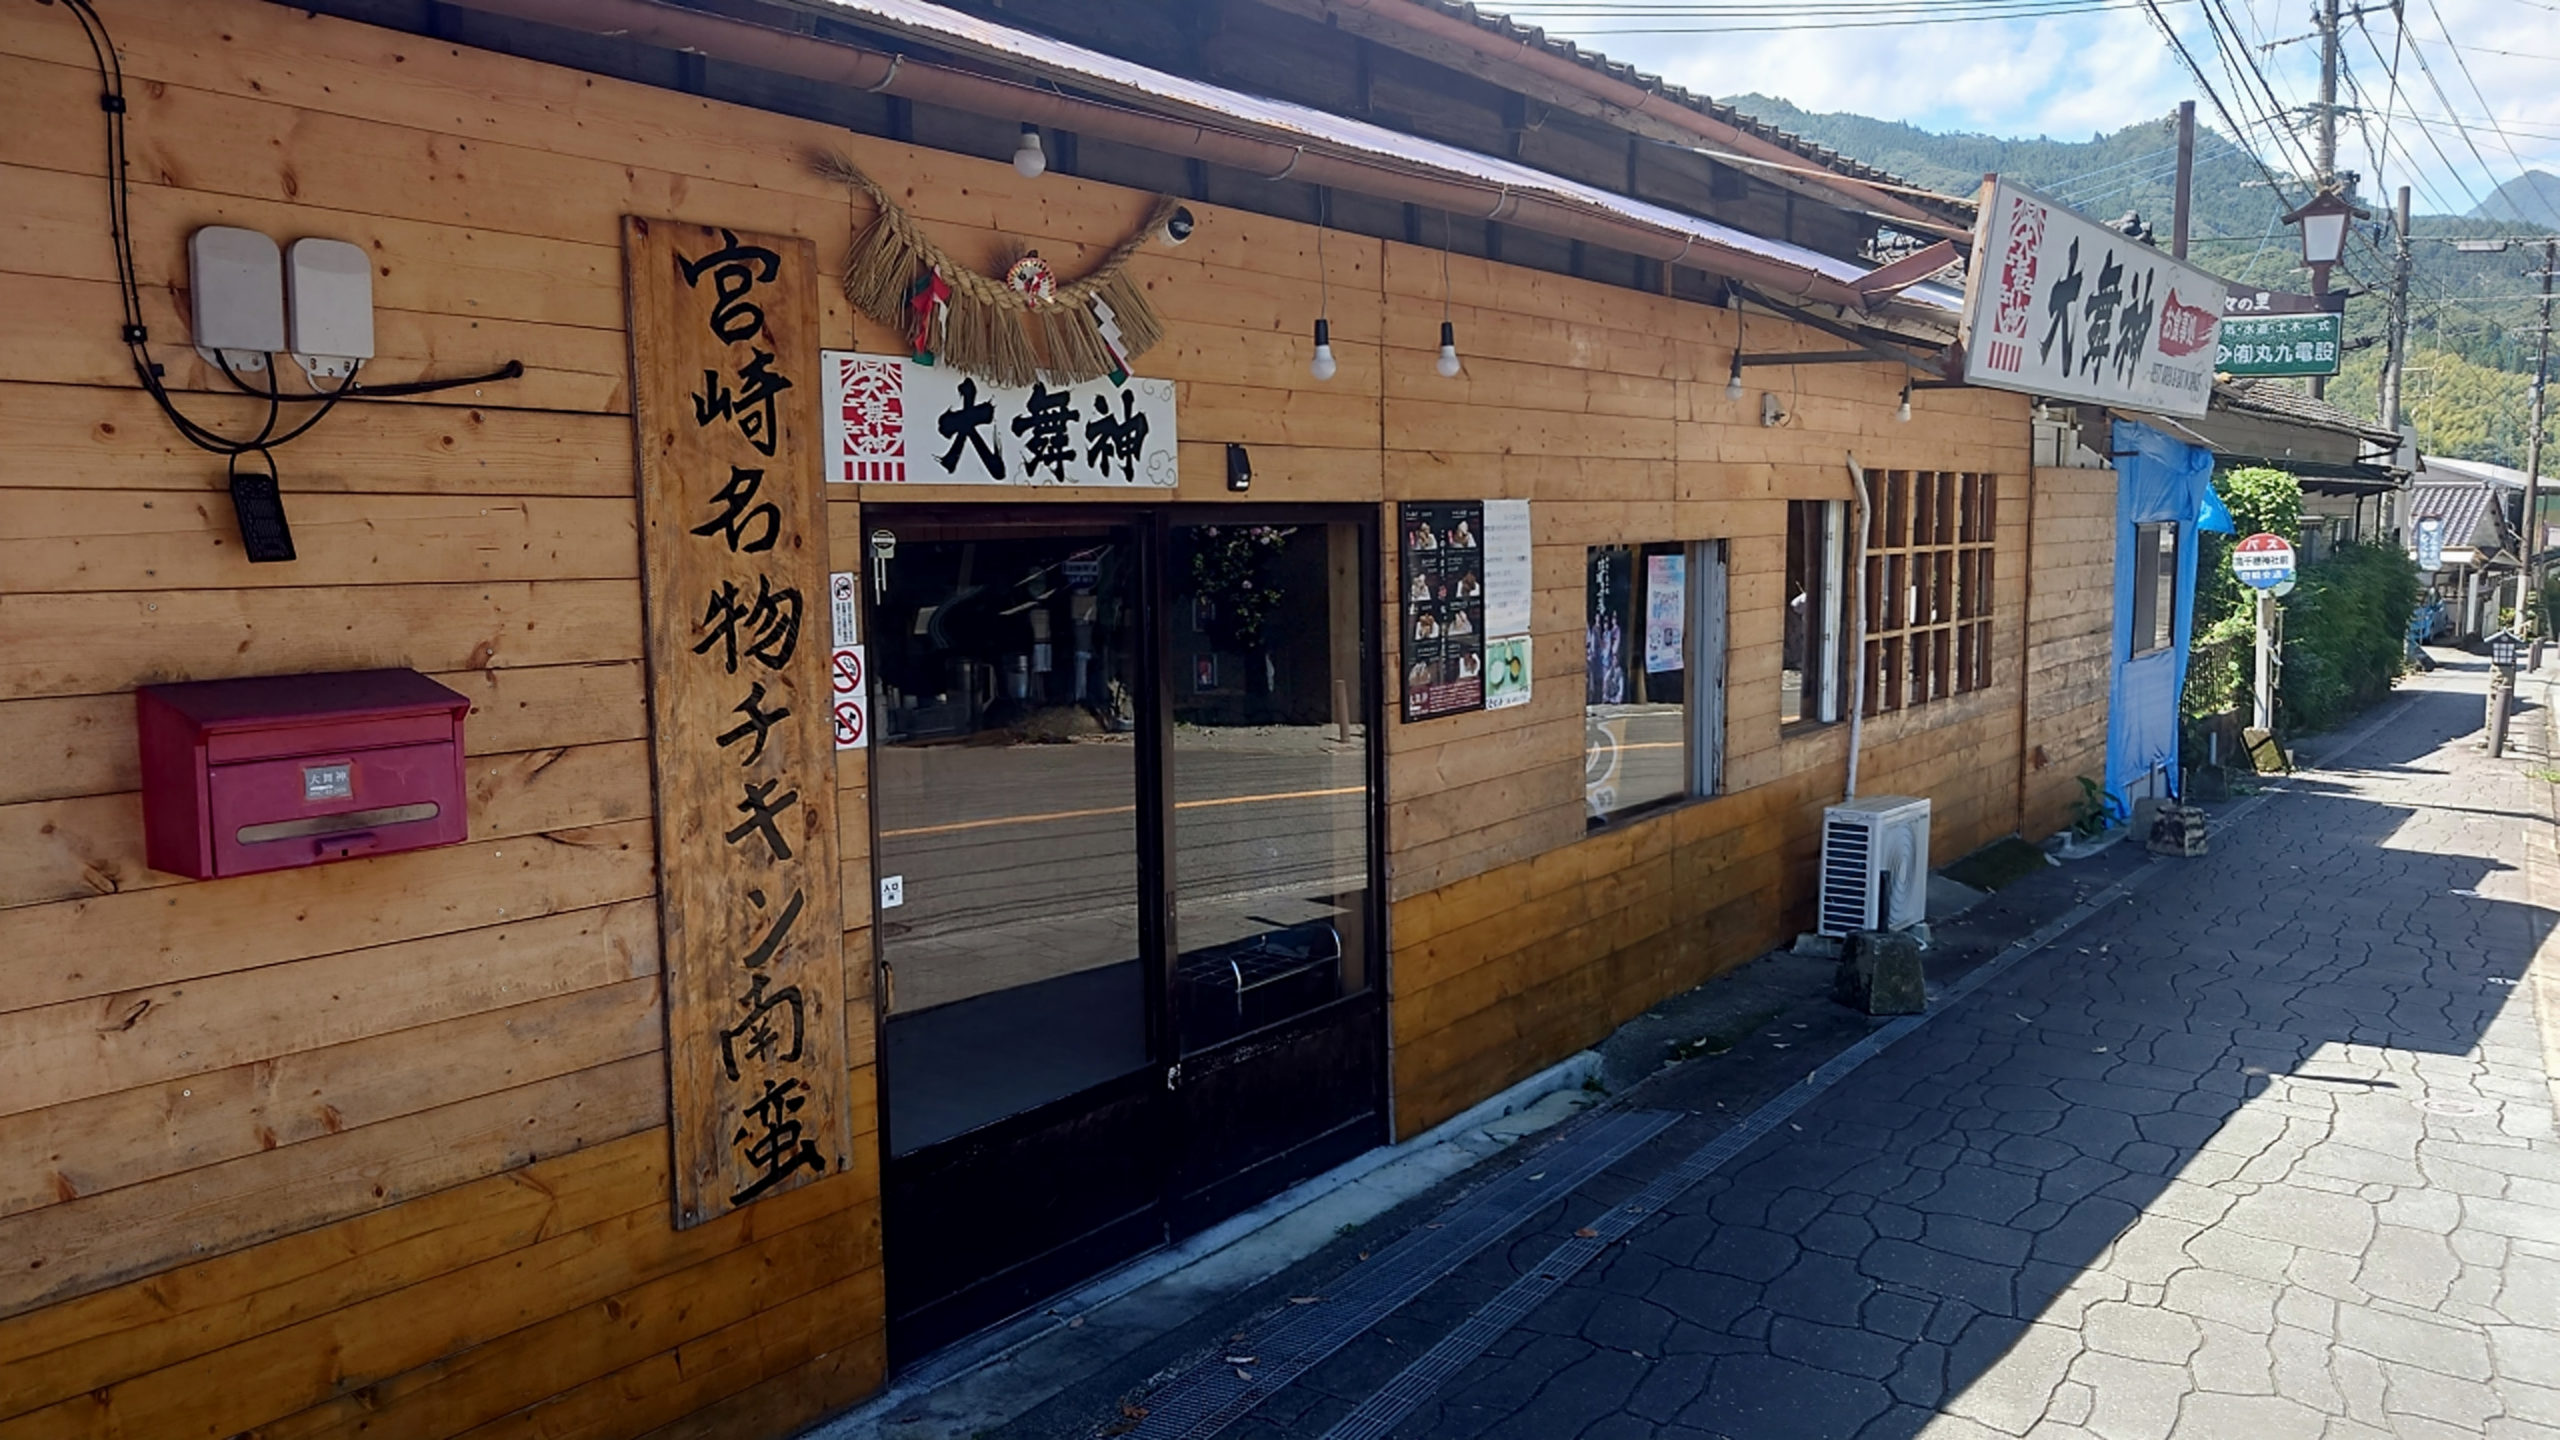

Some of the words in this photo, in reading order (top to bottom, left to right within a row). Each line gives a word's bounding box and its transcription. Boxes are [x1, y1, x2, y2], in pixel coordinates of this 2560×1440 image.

[2040, 235, 2155, 391] 大舞神
[2219, 320, 2331, 336] 気・水道・土木一式
[931, 377, 1150, 482] 大舞神
[2245, 539, 2278, 550] バス
[677, 228, 826, 1206] 宮崎名物チキン南蛮
